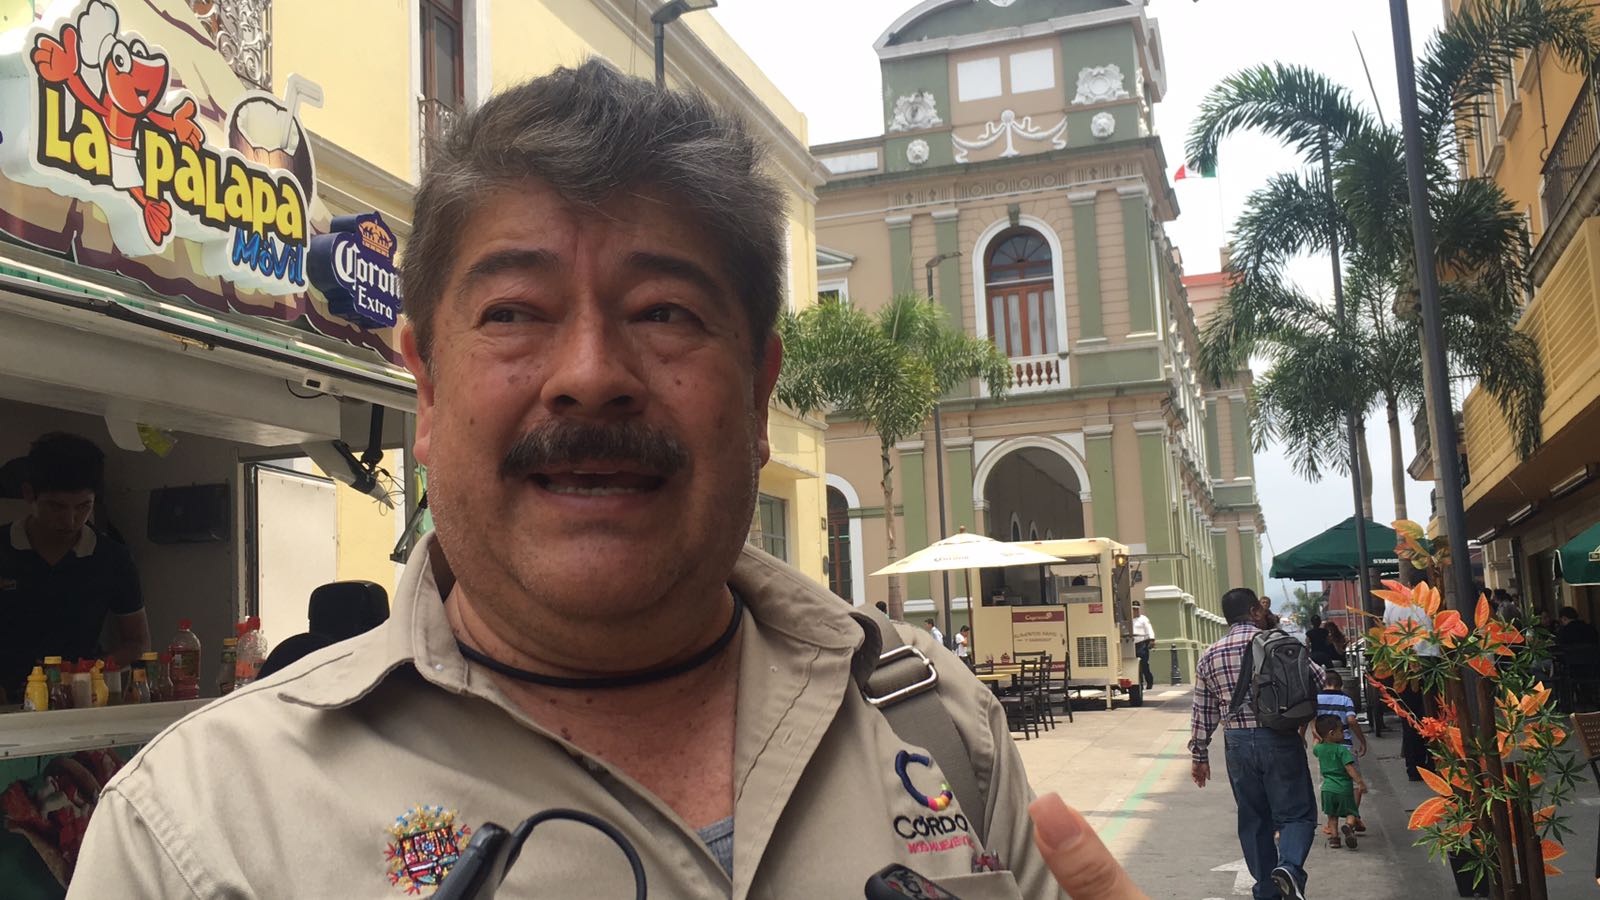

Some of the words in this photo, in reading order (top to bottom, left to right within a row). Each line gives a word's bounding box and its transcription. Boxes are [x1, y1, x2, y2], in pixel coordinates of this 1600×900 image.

[45, 87, 111, 177] La
[335, 240, 404, 300] Coron
[358, 285, 393, 320] Extra
